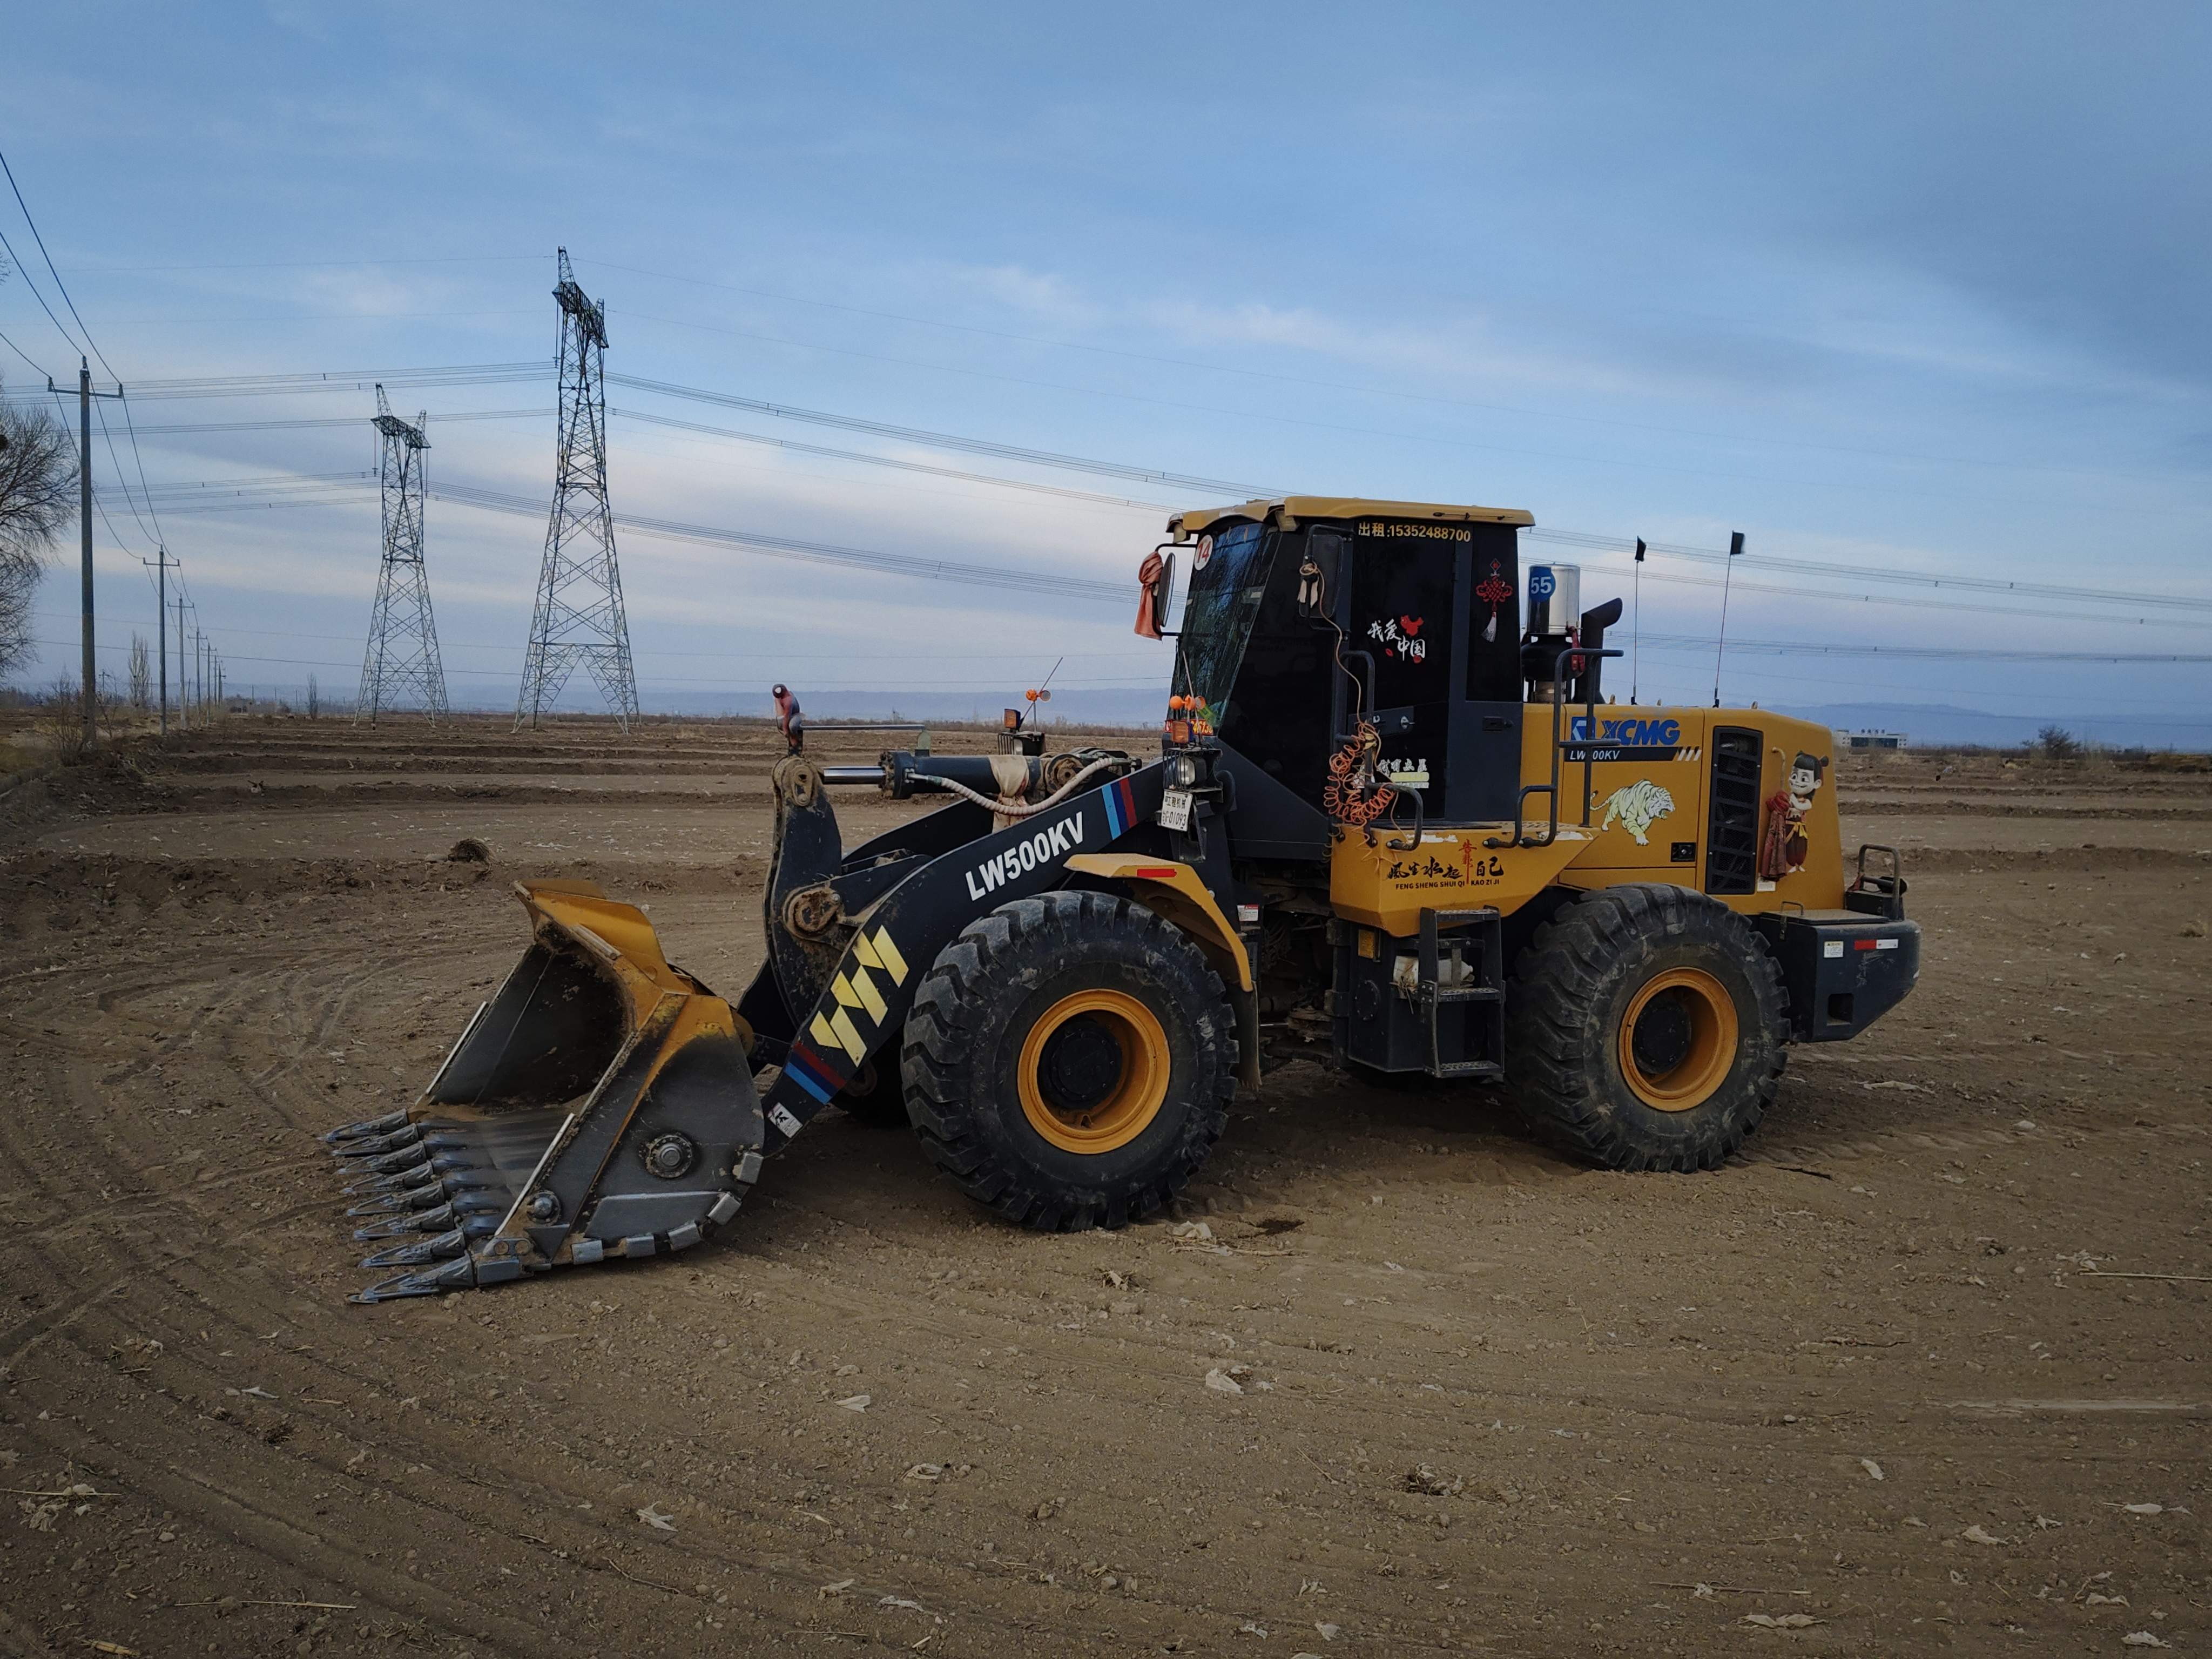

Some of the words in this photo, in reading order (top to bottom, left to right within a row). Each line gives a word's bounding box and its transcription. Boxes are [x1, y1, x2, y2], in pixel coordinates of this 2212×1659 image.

[1197, 541, 1211, 563] 14
[1531, 576, 1552, 594] 55
[1601, 719, 1681, 745] XCMG
[1570, 750, 1620, 760] LW00KV
[965, 811, 1083, 901] LW500KV
